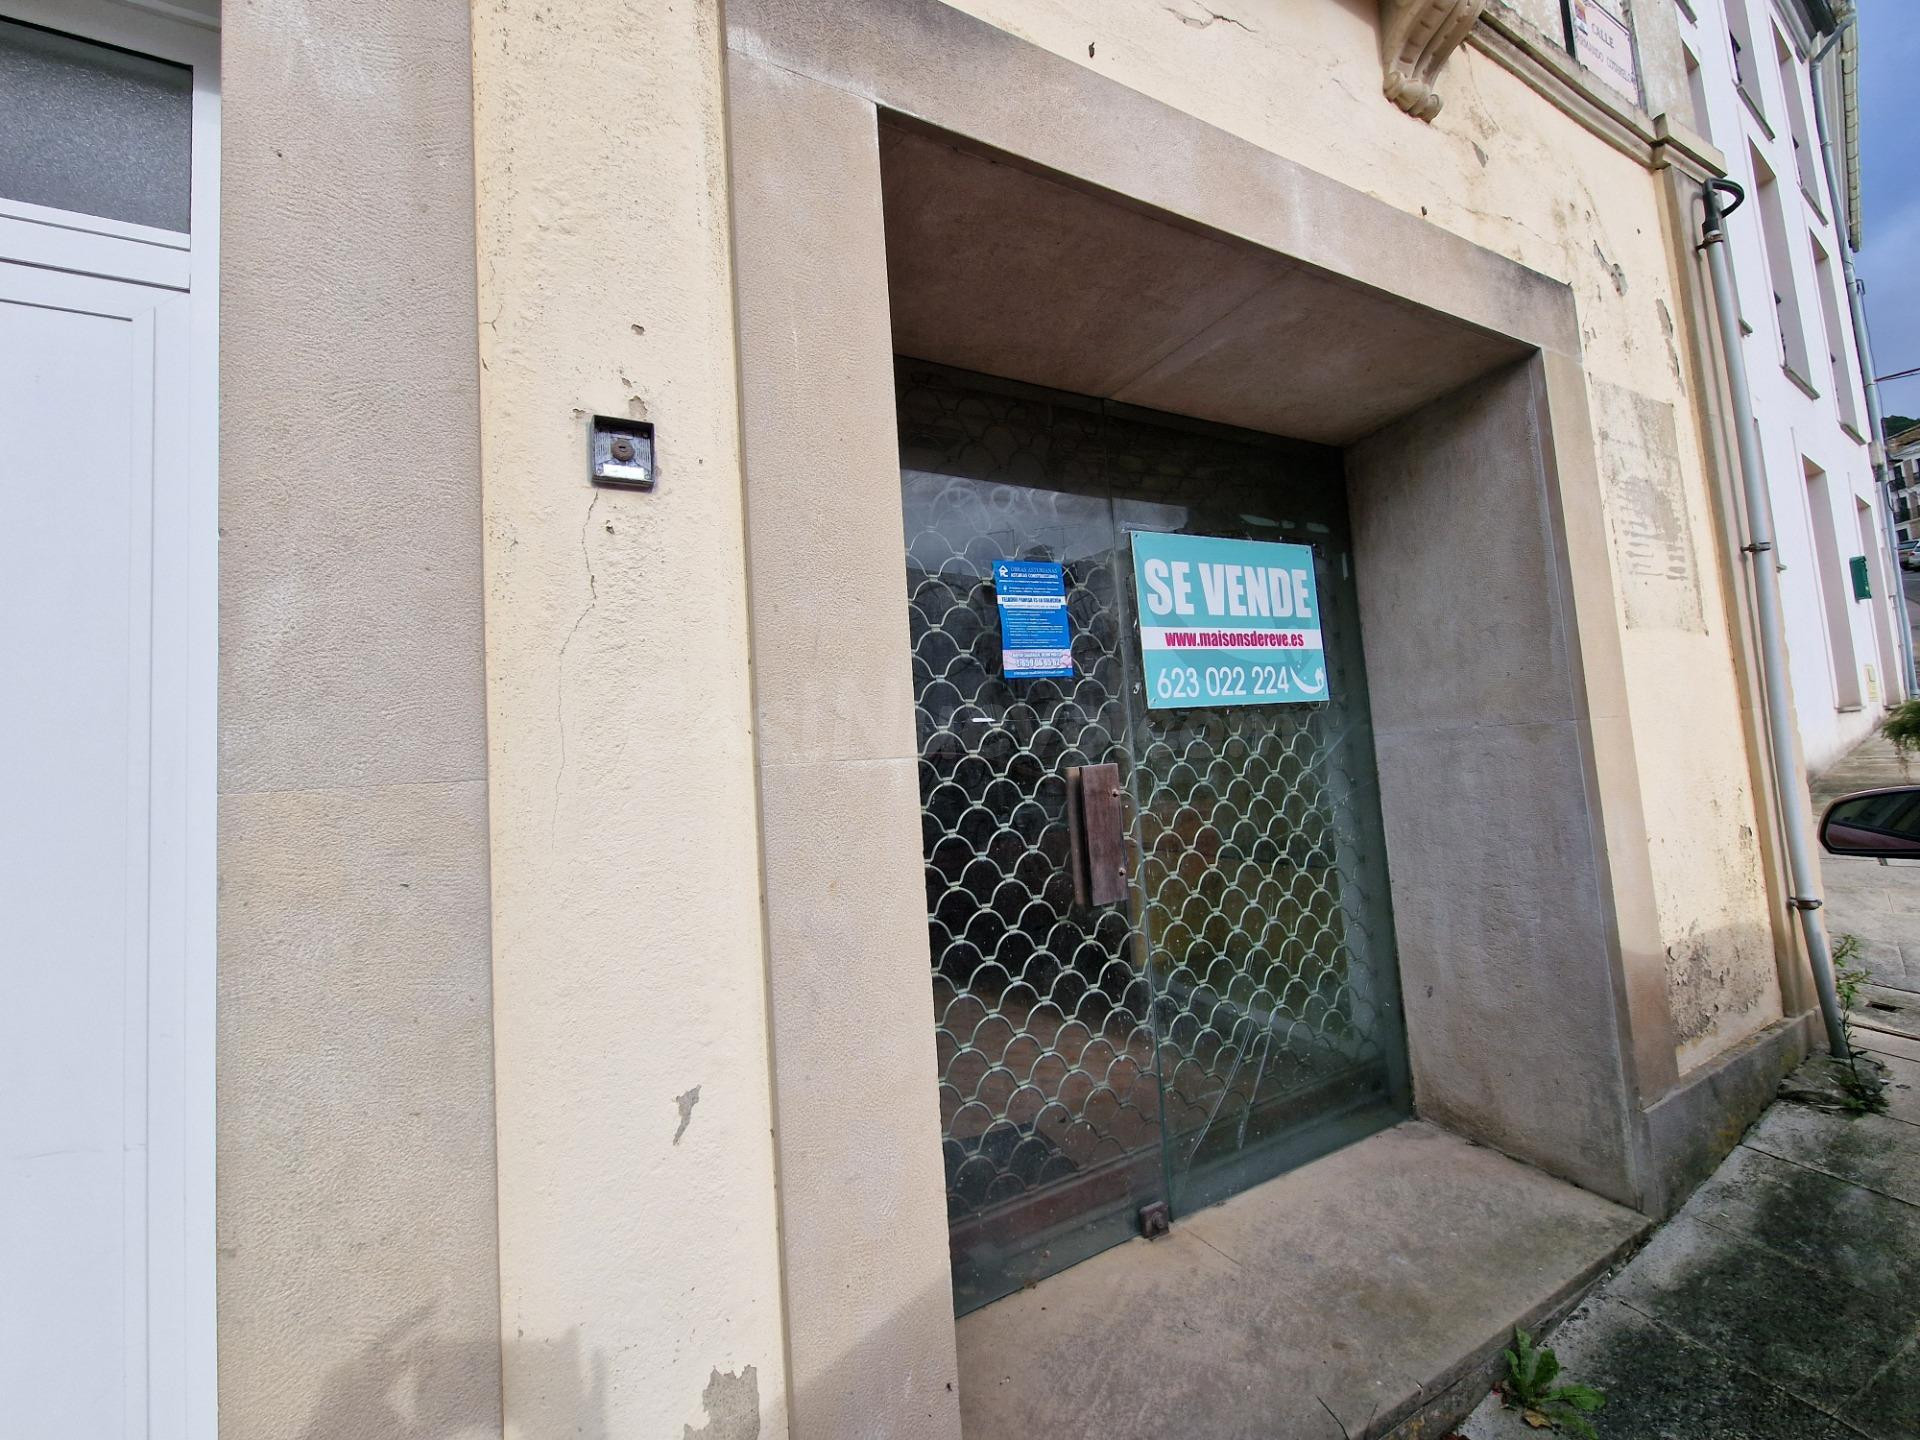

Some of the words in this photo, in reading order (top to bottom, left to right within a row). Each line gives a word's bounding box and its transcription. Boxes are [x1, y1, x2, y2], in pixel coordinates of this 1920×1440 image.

[1144, 558, 1195, 615] SE
[1199, 563, 1312, 618] VENDE
[1165, 630, 1304, 647] www.maisonsdereve.es
[1157, 667, 1200, 698] 623
[1205, 667, 1247, 697] 022
[1251, 665, 1289, 694] 224
